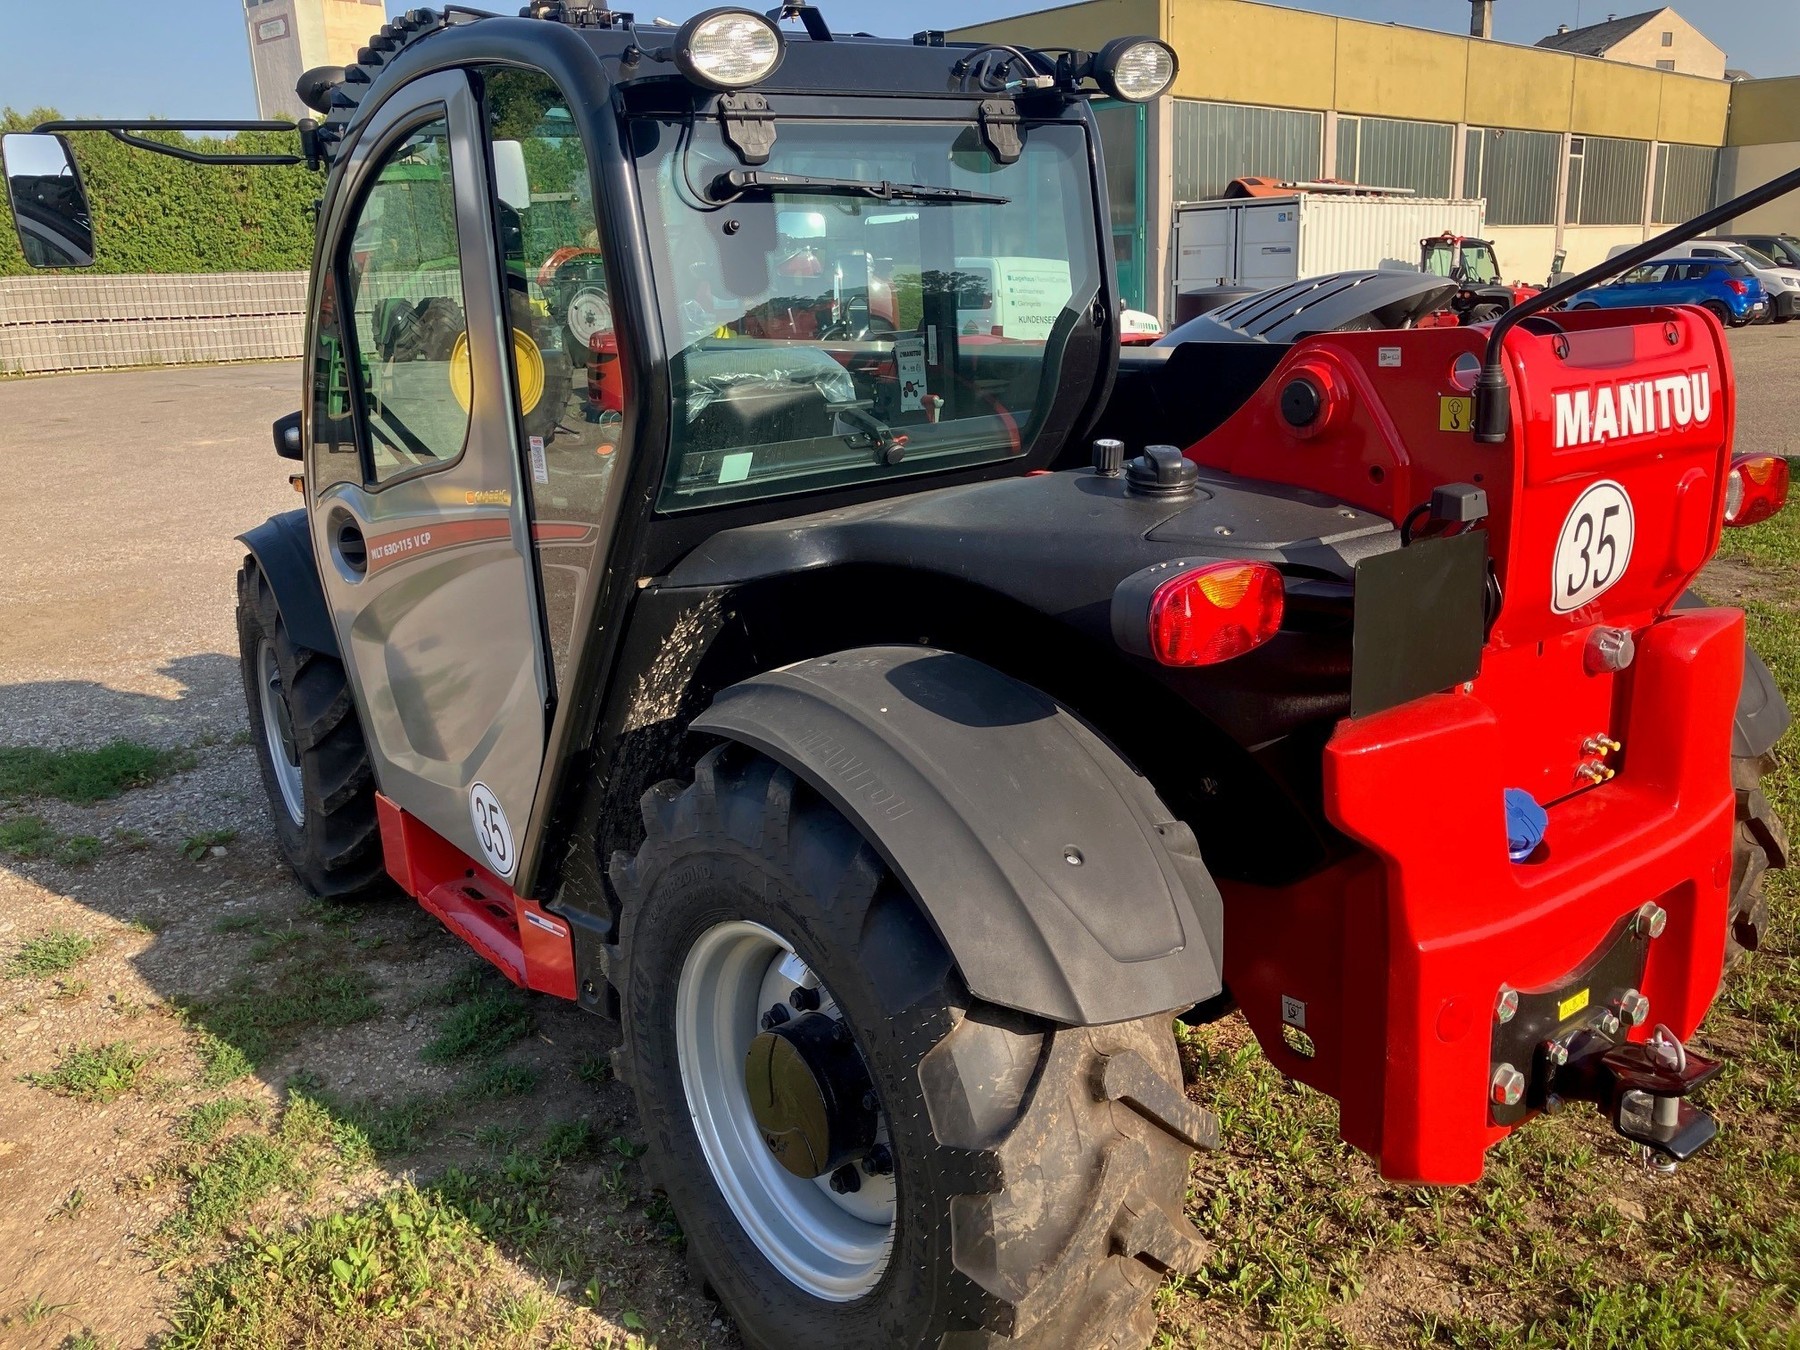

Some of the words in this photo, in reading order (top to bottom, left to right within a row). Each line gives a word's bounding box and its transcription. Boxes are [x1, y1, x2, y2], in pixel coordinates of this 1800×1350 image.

[1555, 371, 1711, 449] MANITOU
[370, 546, 384, 560] MLT
[383, 537, 413, 557] 630-115
[1566, 504, 1620, 597] 35
[795, 730, 914, 822] MANITOU
[476, 796, 506, 862] 35
